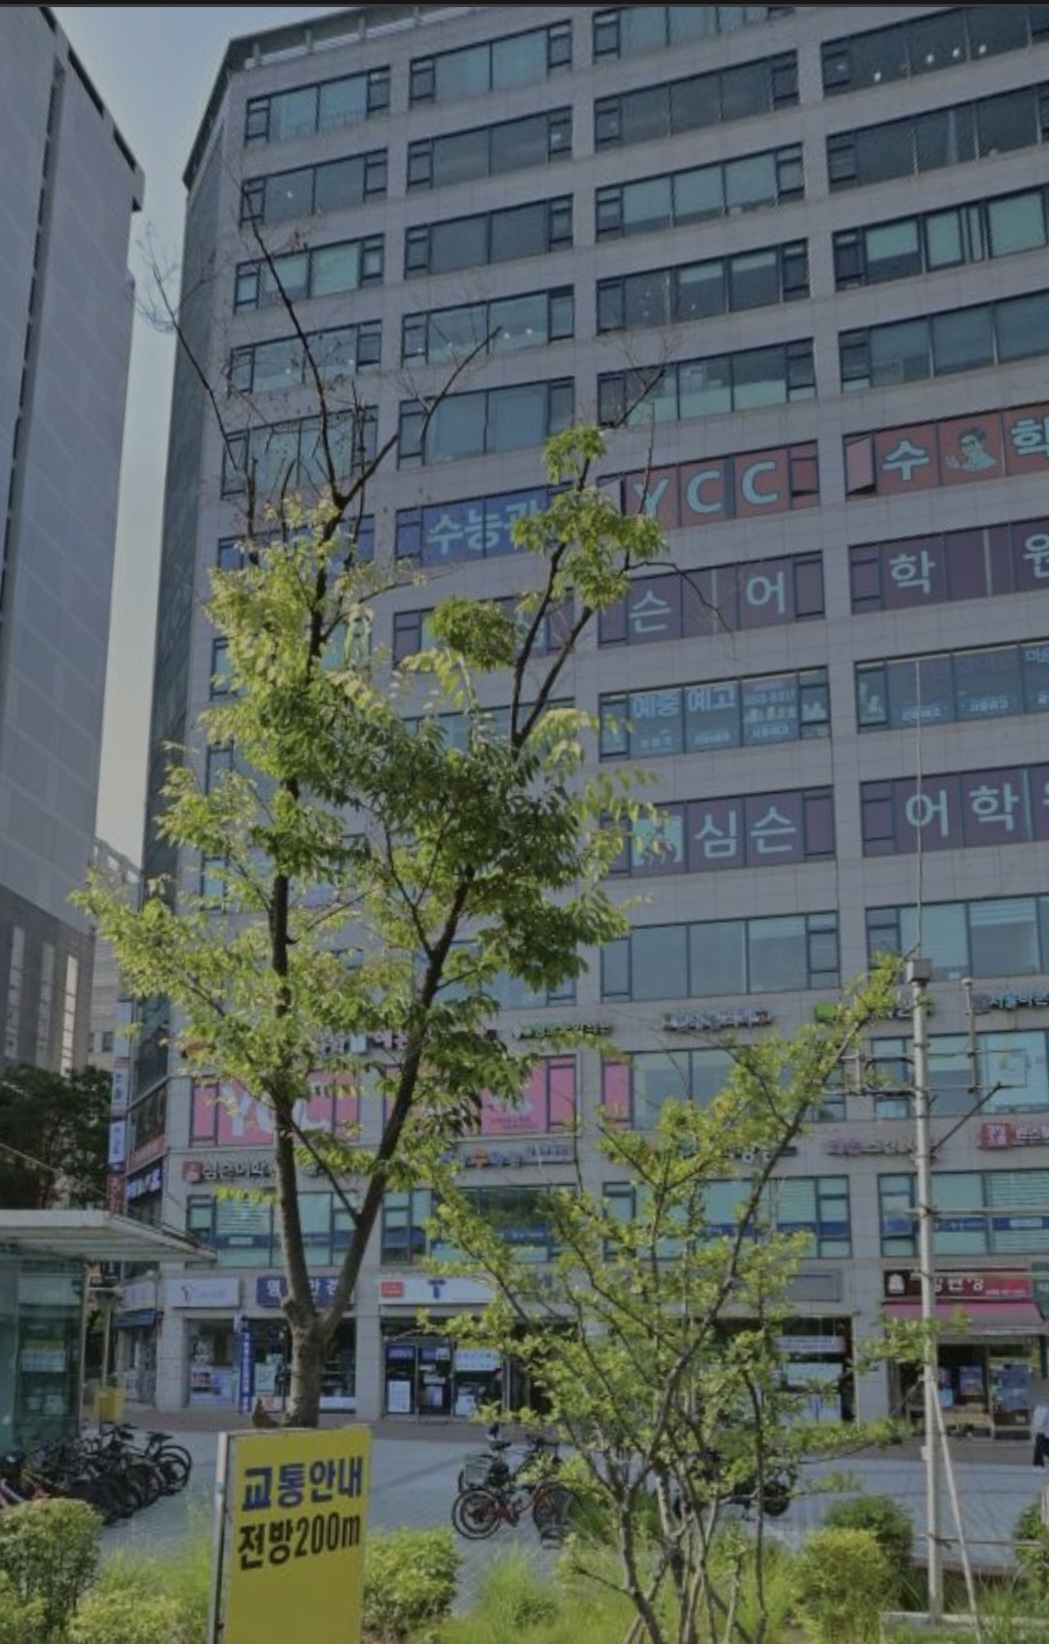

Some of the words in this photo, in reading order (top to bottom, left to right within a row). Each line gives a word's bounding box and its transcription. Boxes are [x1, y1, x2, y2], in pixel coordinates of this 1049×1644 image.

[632, 460, 778, 518] YCC
[242, 1456, 364, 1512] 교통안내
[238, 1512, 361, 1571] 전방200m
